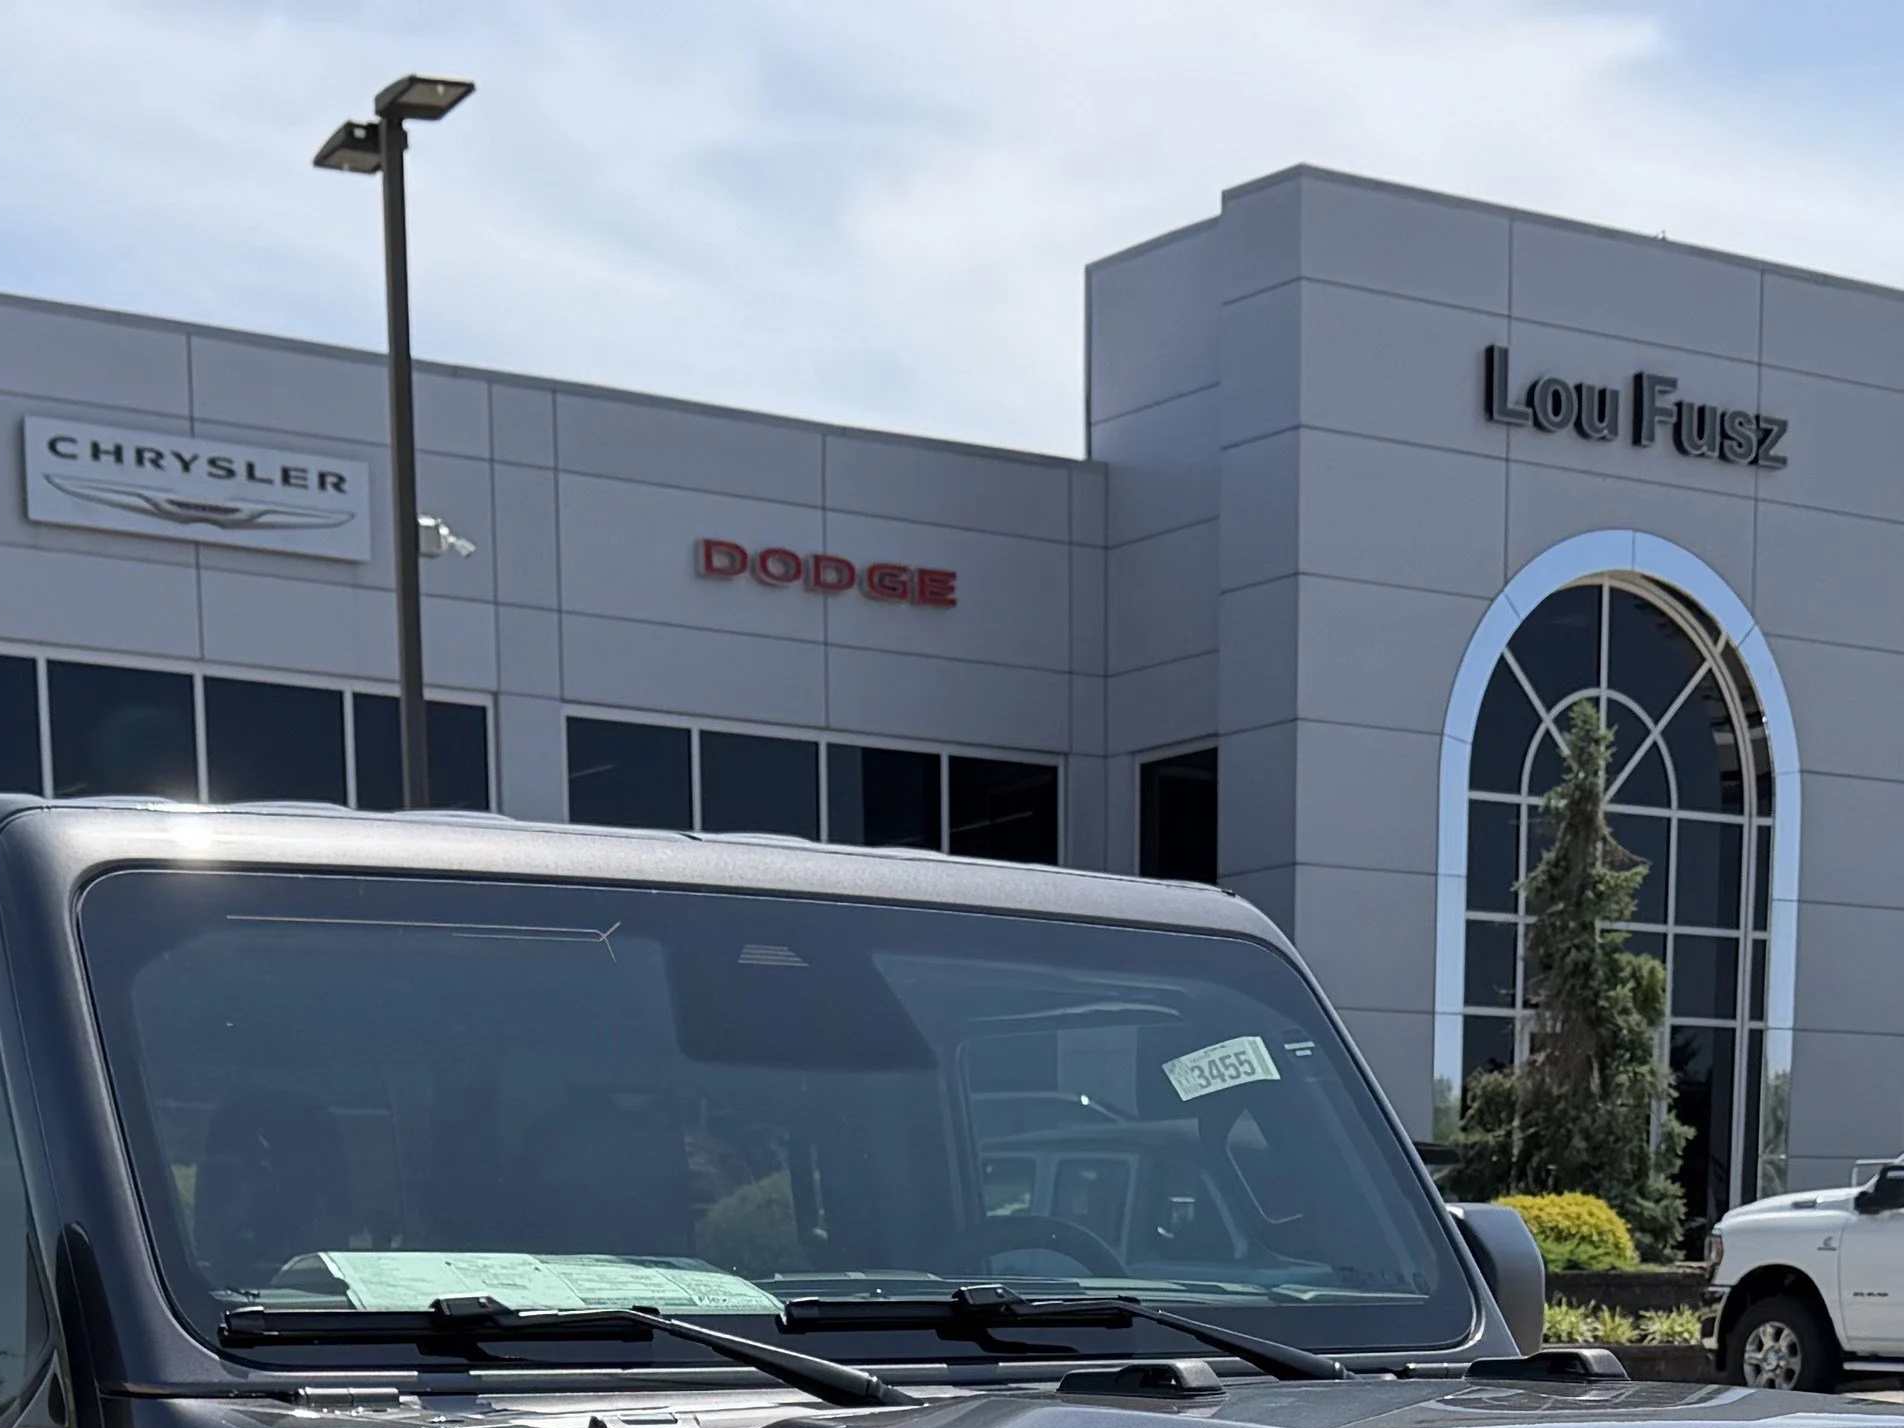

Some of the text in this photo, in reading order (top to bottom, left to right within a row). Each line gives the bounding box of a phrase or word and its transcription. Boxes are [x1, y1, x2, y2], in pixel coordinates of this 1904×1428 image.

[1484, 344, 1788, 469] Lou Fusz
[47, 435, 347, 494] CHRYSLER
[696, 537, 958, 609] DODGE
[1191, 1051, 1256, 1089] 3455
